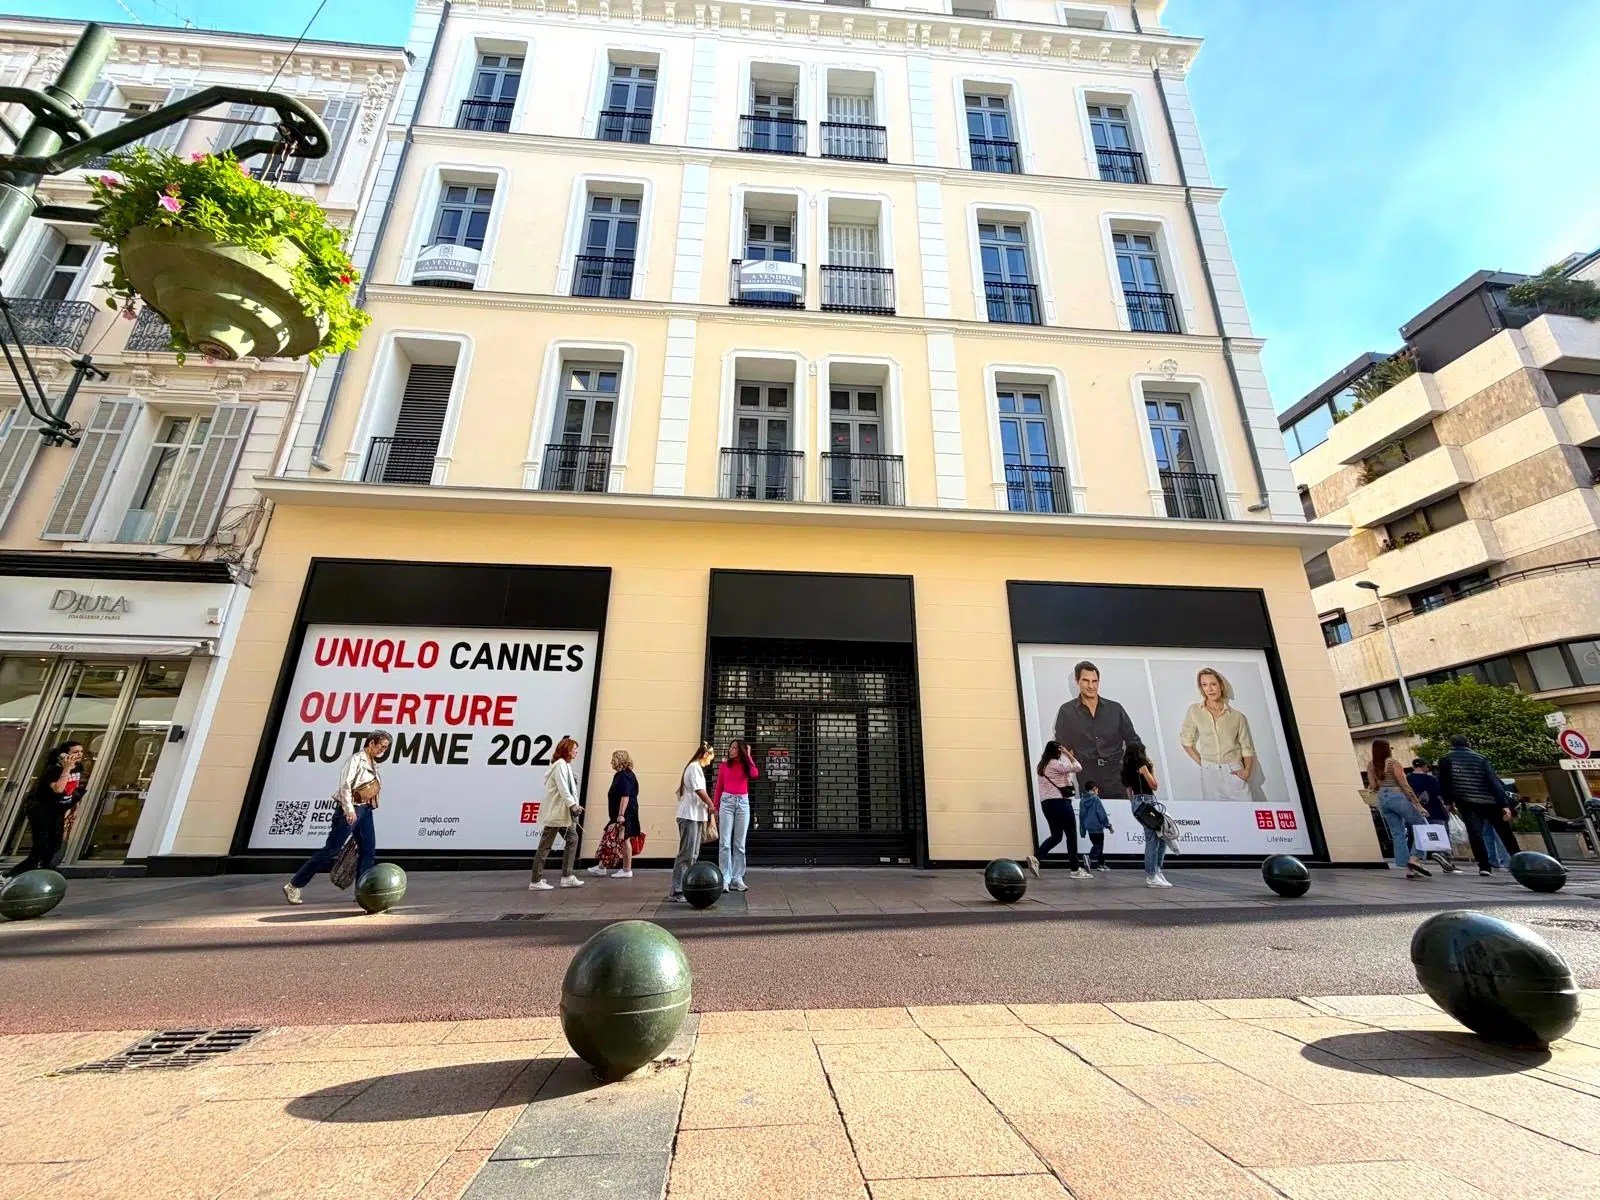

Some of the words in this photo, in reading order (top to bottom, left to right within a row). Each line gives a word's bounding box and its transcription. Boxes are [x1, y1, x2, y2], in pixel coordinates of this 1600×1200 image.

[48, 589, 129, 613] DJULA
[314, 637, 440, 673] UNIQLO
[449, 641, 585, 672] CANNES
[299, 691, 518, 727] OUVERTURE
[487, 734, 571, 766] 202
[419, 814, 460, 824] uniqlo.com
